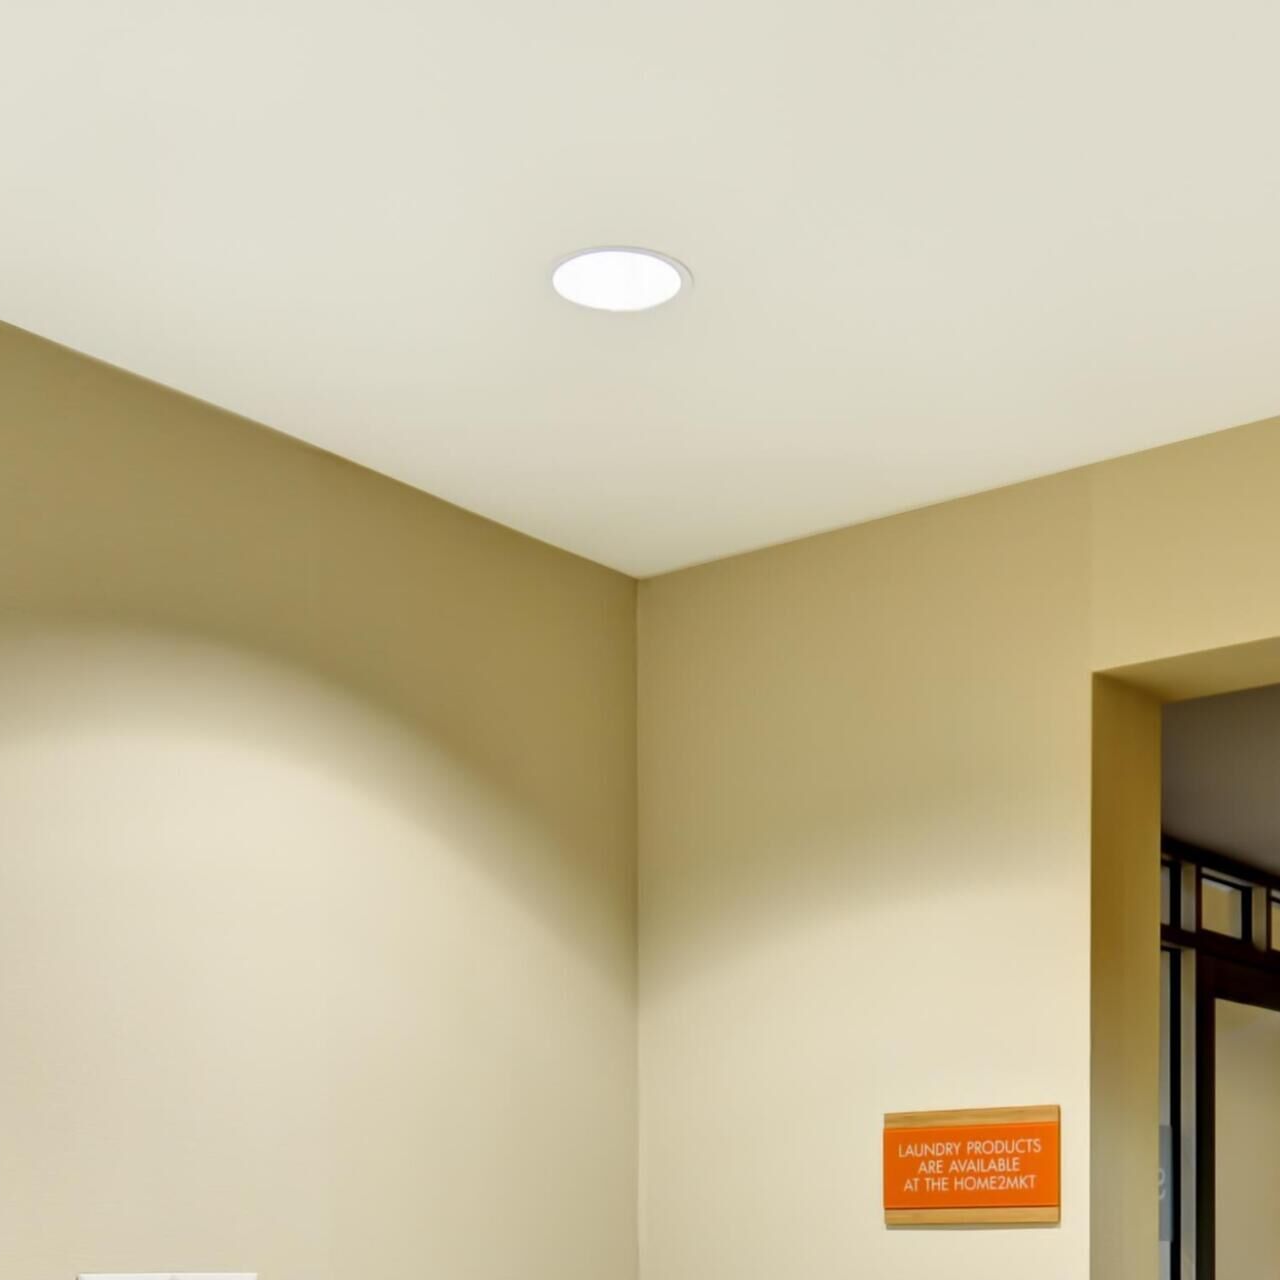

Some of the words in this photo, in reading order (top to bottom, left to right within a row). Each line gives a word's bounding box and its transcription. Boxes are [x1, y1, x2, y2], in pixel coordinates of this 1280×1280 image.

[898, 1142, 961, 1158] LAUNDRY
[967, 1138, 1041, 1154] PRODUCTS
[918, 1160, 943, 1174] ARE
[949, 1157, 1020, 1173] AVAILABLE
[904, 1178, 919, 1192] AT
[925, 1177, 948, 1191] THE
[954, 1175, 1036, 1191] HOME2MKT
